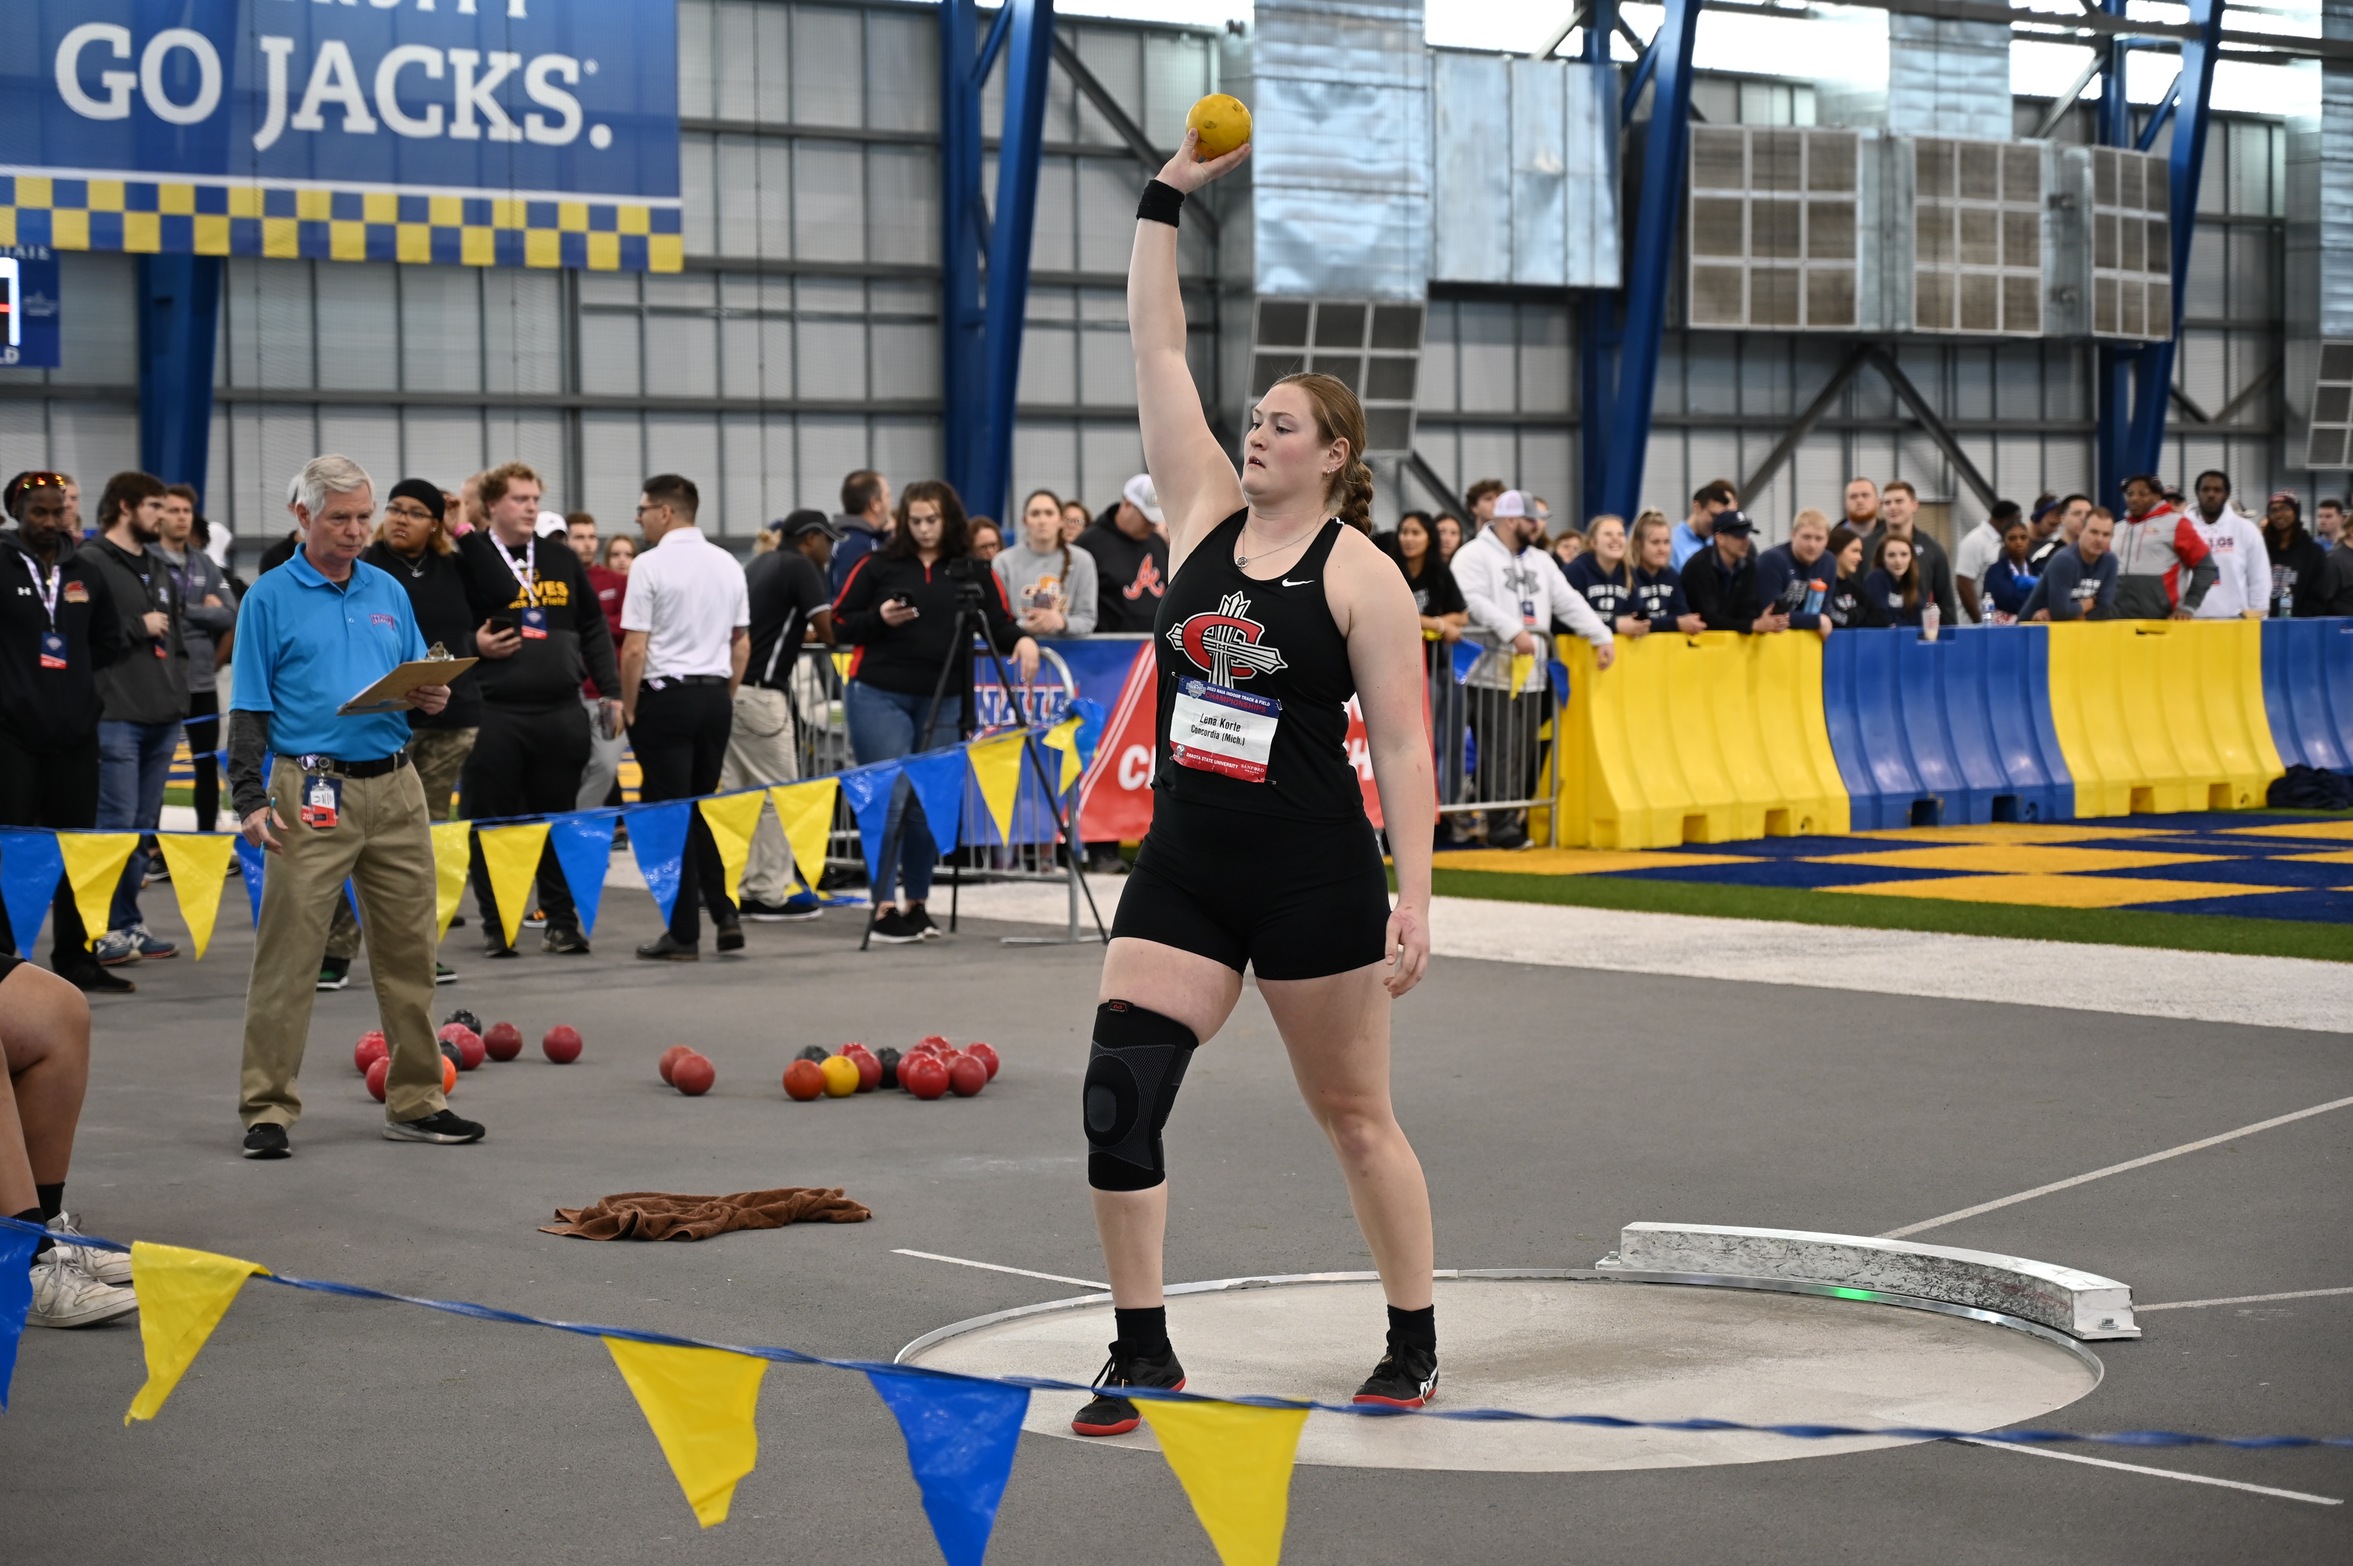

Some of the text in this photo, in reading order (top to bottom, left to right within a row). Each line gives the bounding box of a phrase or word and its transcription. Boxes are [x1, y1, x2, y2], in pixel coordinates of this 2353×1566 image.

[54, 22, 224, 125] GO
[1204, 691, 1267, 713] CHAMPIONSHIPS
[1225, 691, 1242, 699] INDOOR
[1241, 695, 1255, 703] TRACK
[1258, 699, 1271, 707] FIELD
[1199, 713, 1241, 733] Lena Korte
[1190, 724, 1246, 747] Concordia (Mich.)
[1186, 752, 1239, 769] DAKOTA STATE UNIVERSITY
